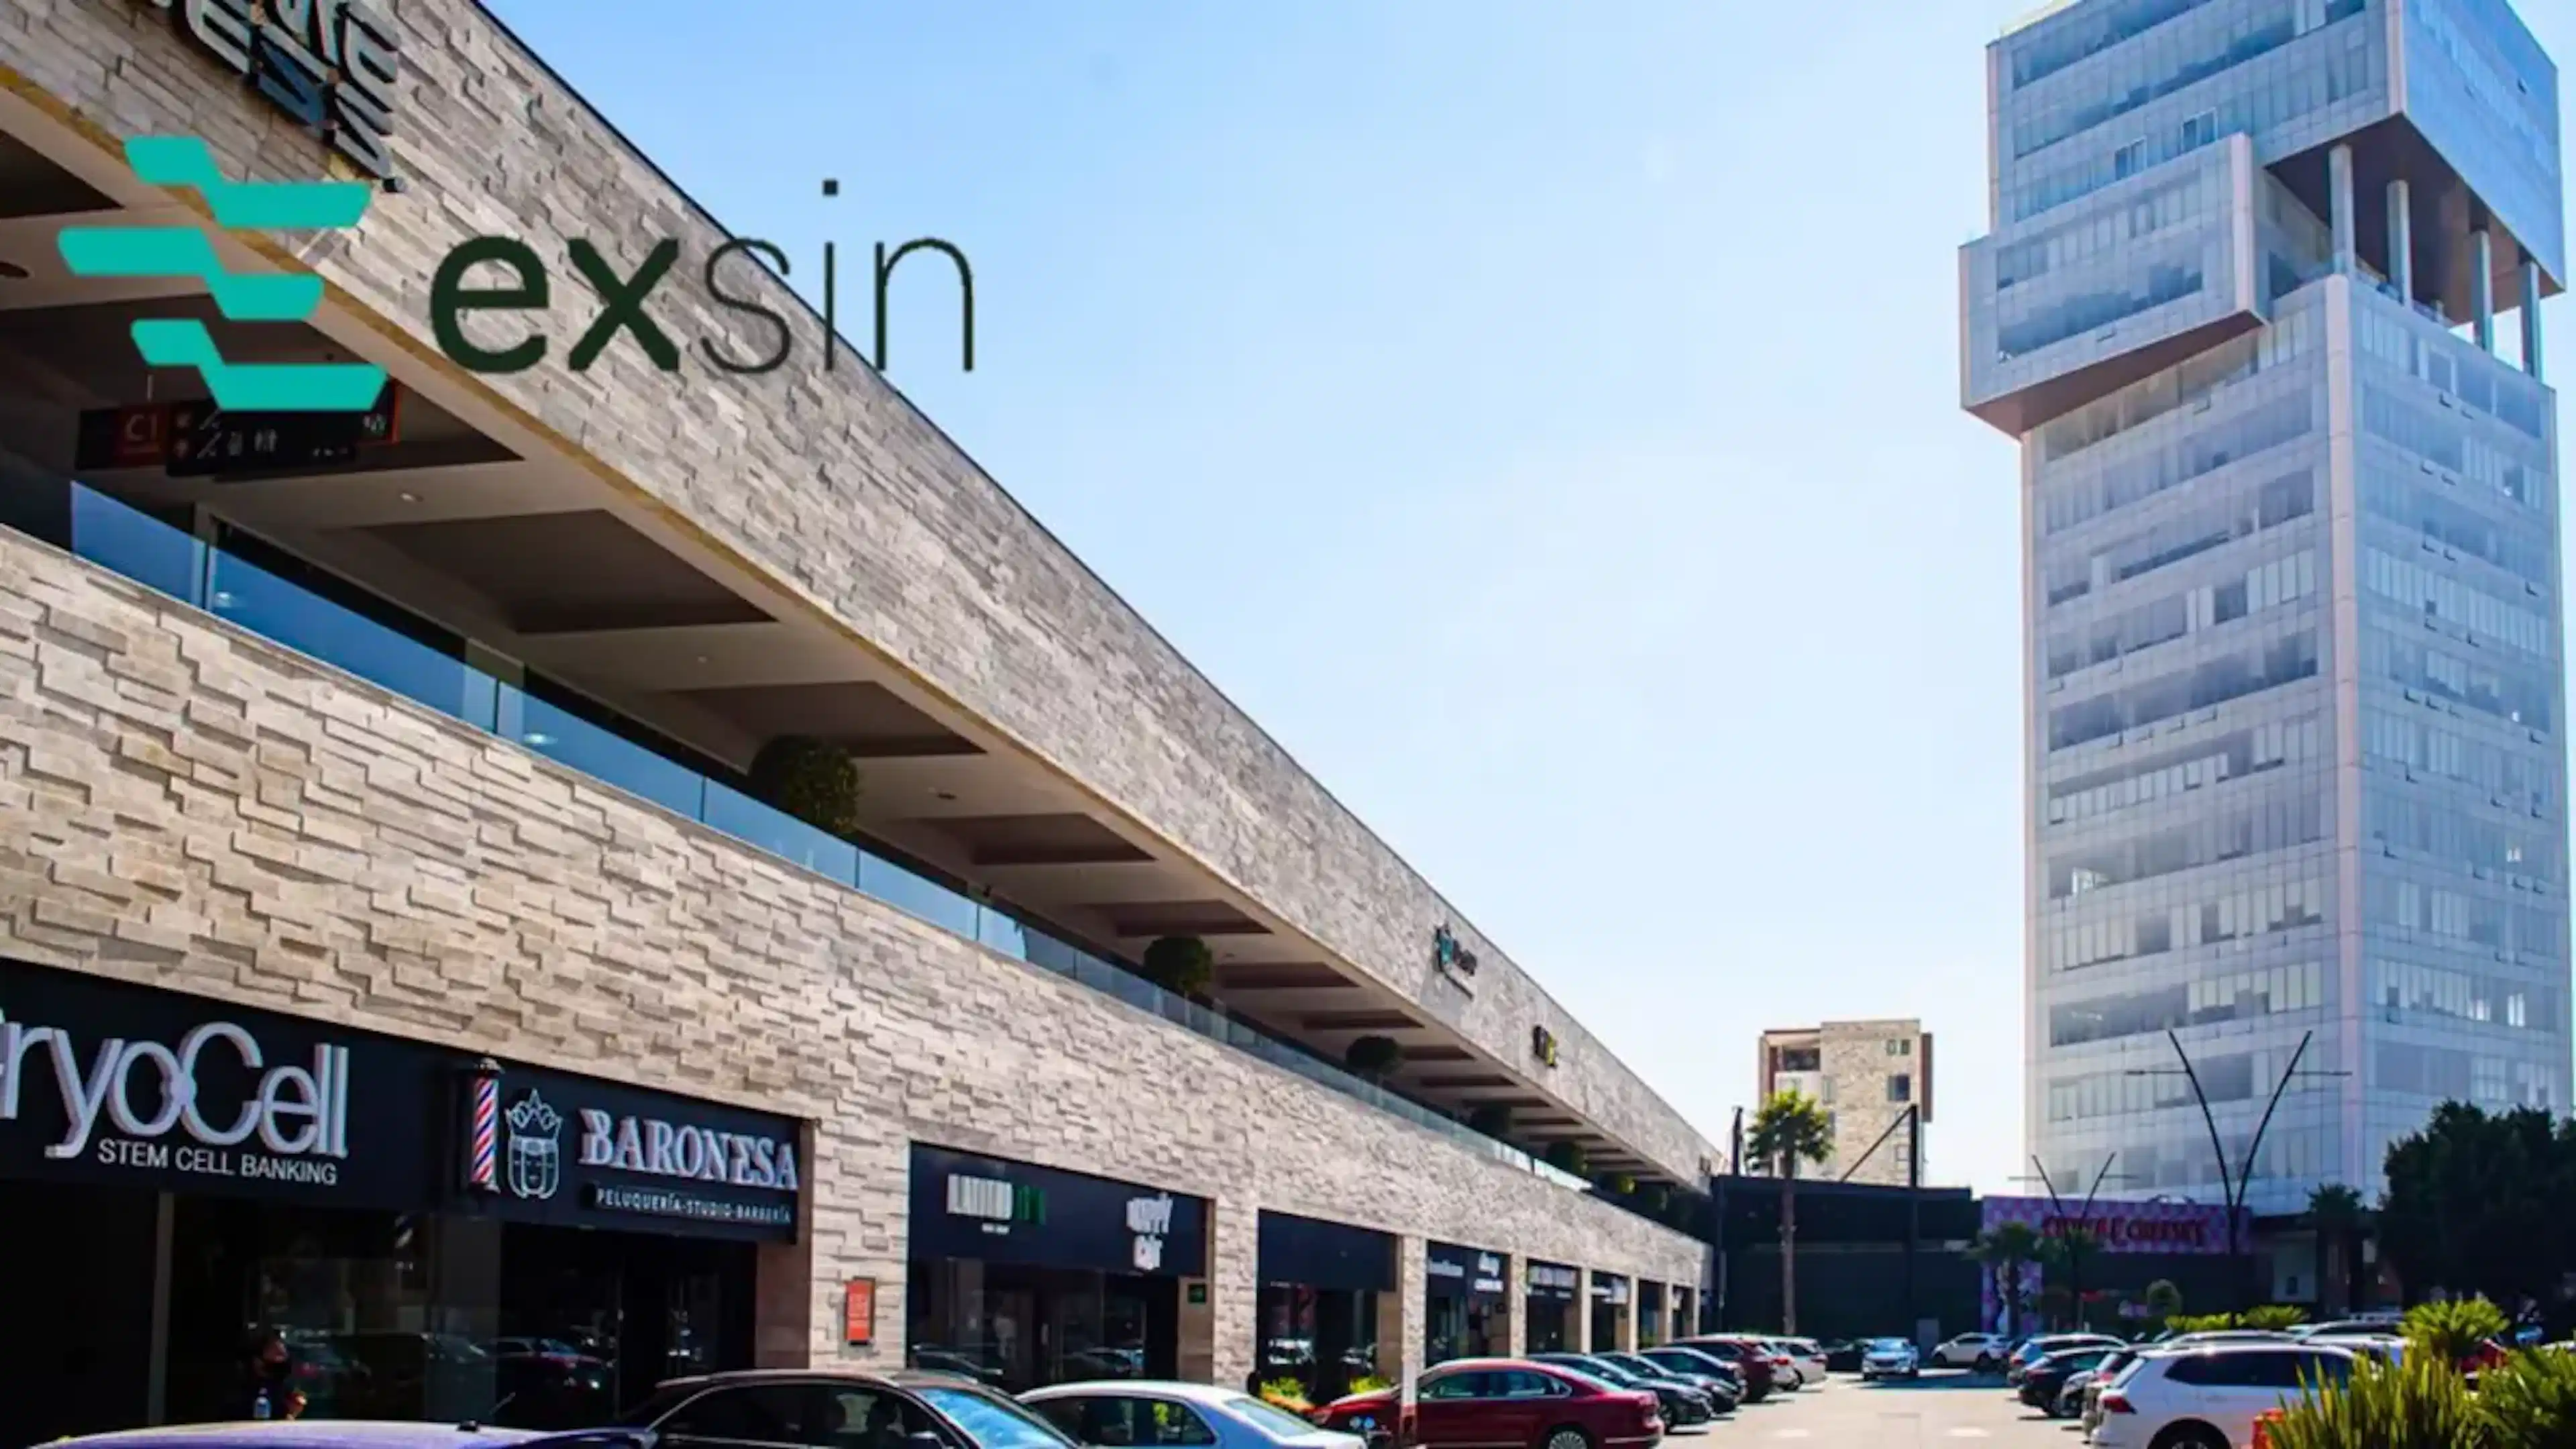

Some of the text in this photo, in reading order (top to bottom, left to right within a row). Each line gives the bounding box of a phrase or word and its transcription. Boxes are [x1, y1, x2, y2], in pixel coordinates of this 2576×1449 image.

[0, 1021, 349, 1159] ryoCell
[97, 1138, 337, 1185] STEM CELL BANKING
[579, 1108, 798, 1190] BARONESA
